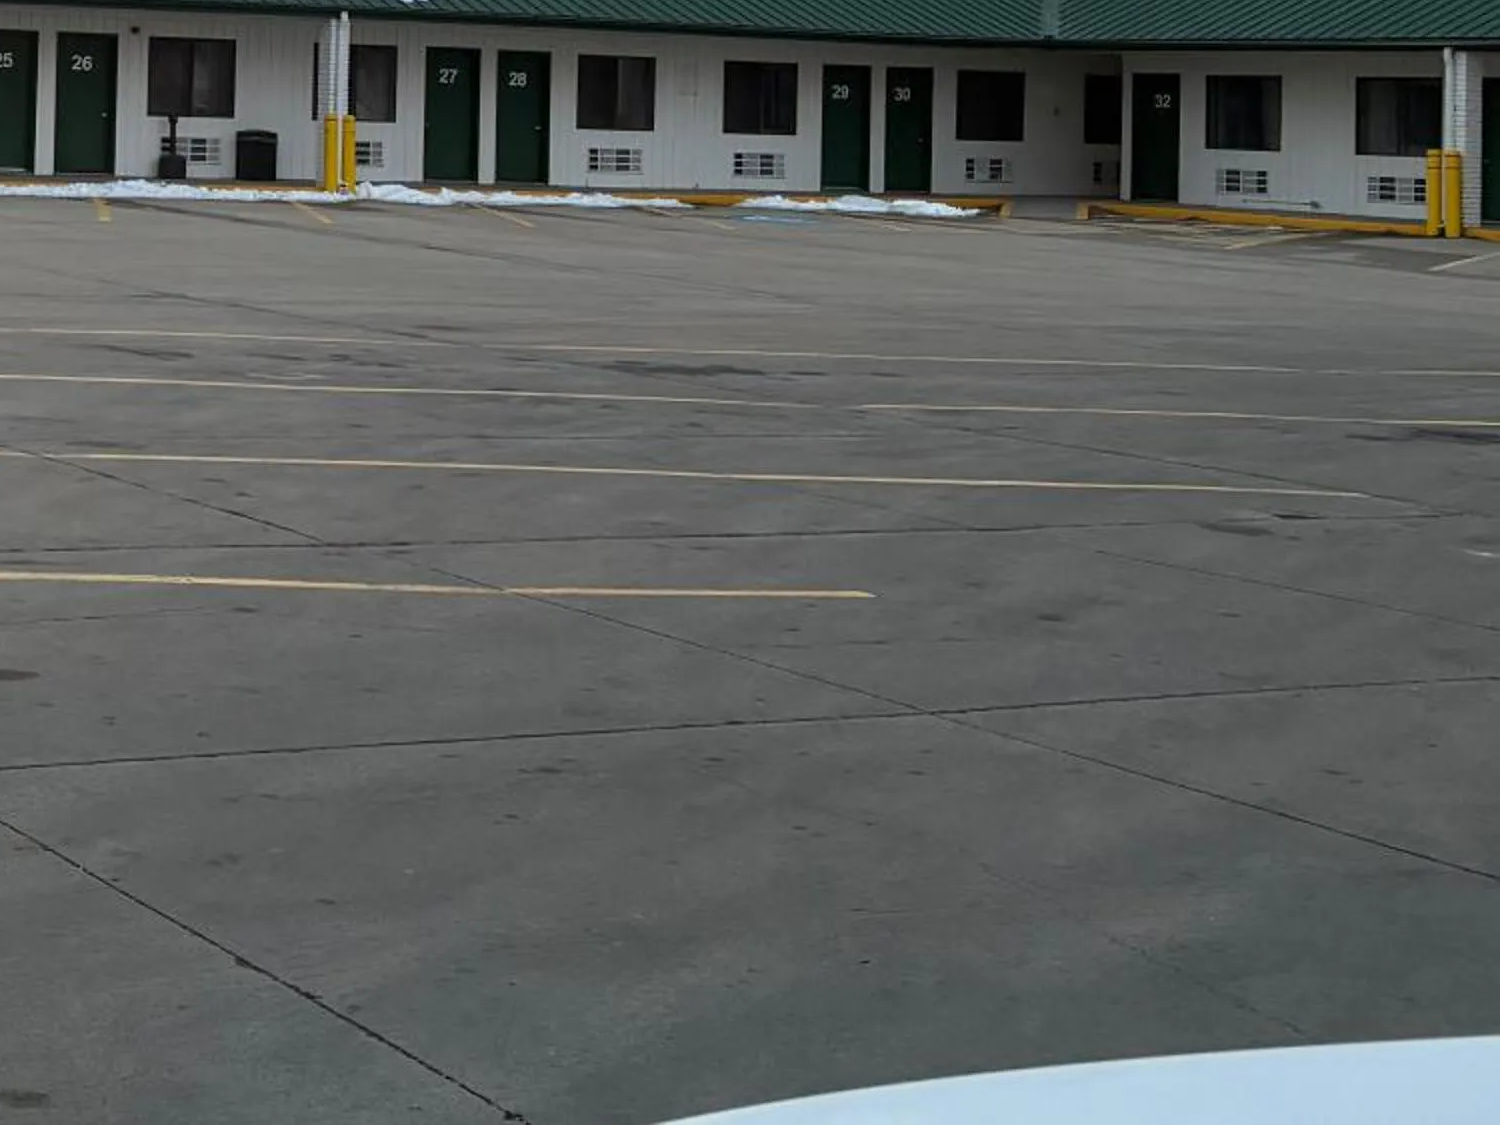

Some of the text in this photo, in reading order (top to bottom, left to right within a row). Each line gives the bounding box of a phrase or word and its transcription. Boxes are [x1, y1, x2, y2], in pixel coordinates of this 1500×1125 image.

[71, 54, 93, 72] 26
[439, 68, 459, 85] 27
[508, 71, 527, 88] 28
[831, 84, 850, 100] 29
[894, 87, 912, 102] 30
[1154, 93, 1172, 109] 32
